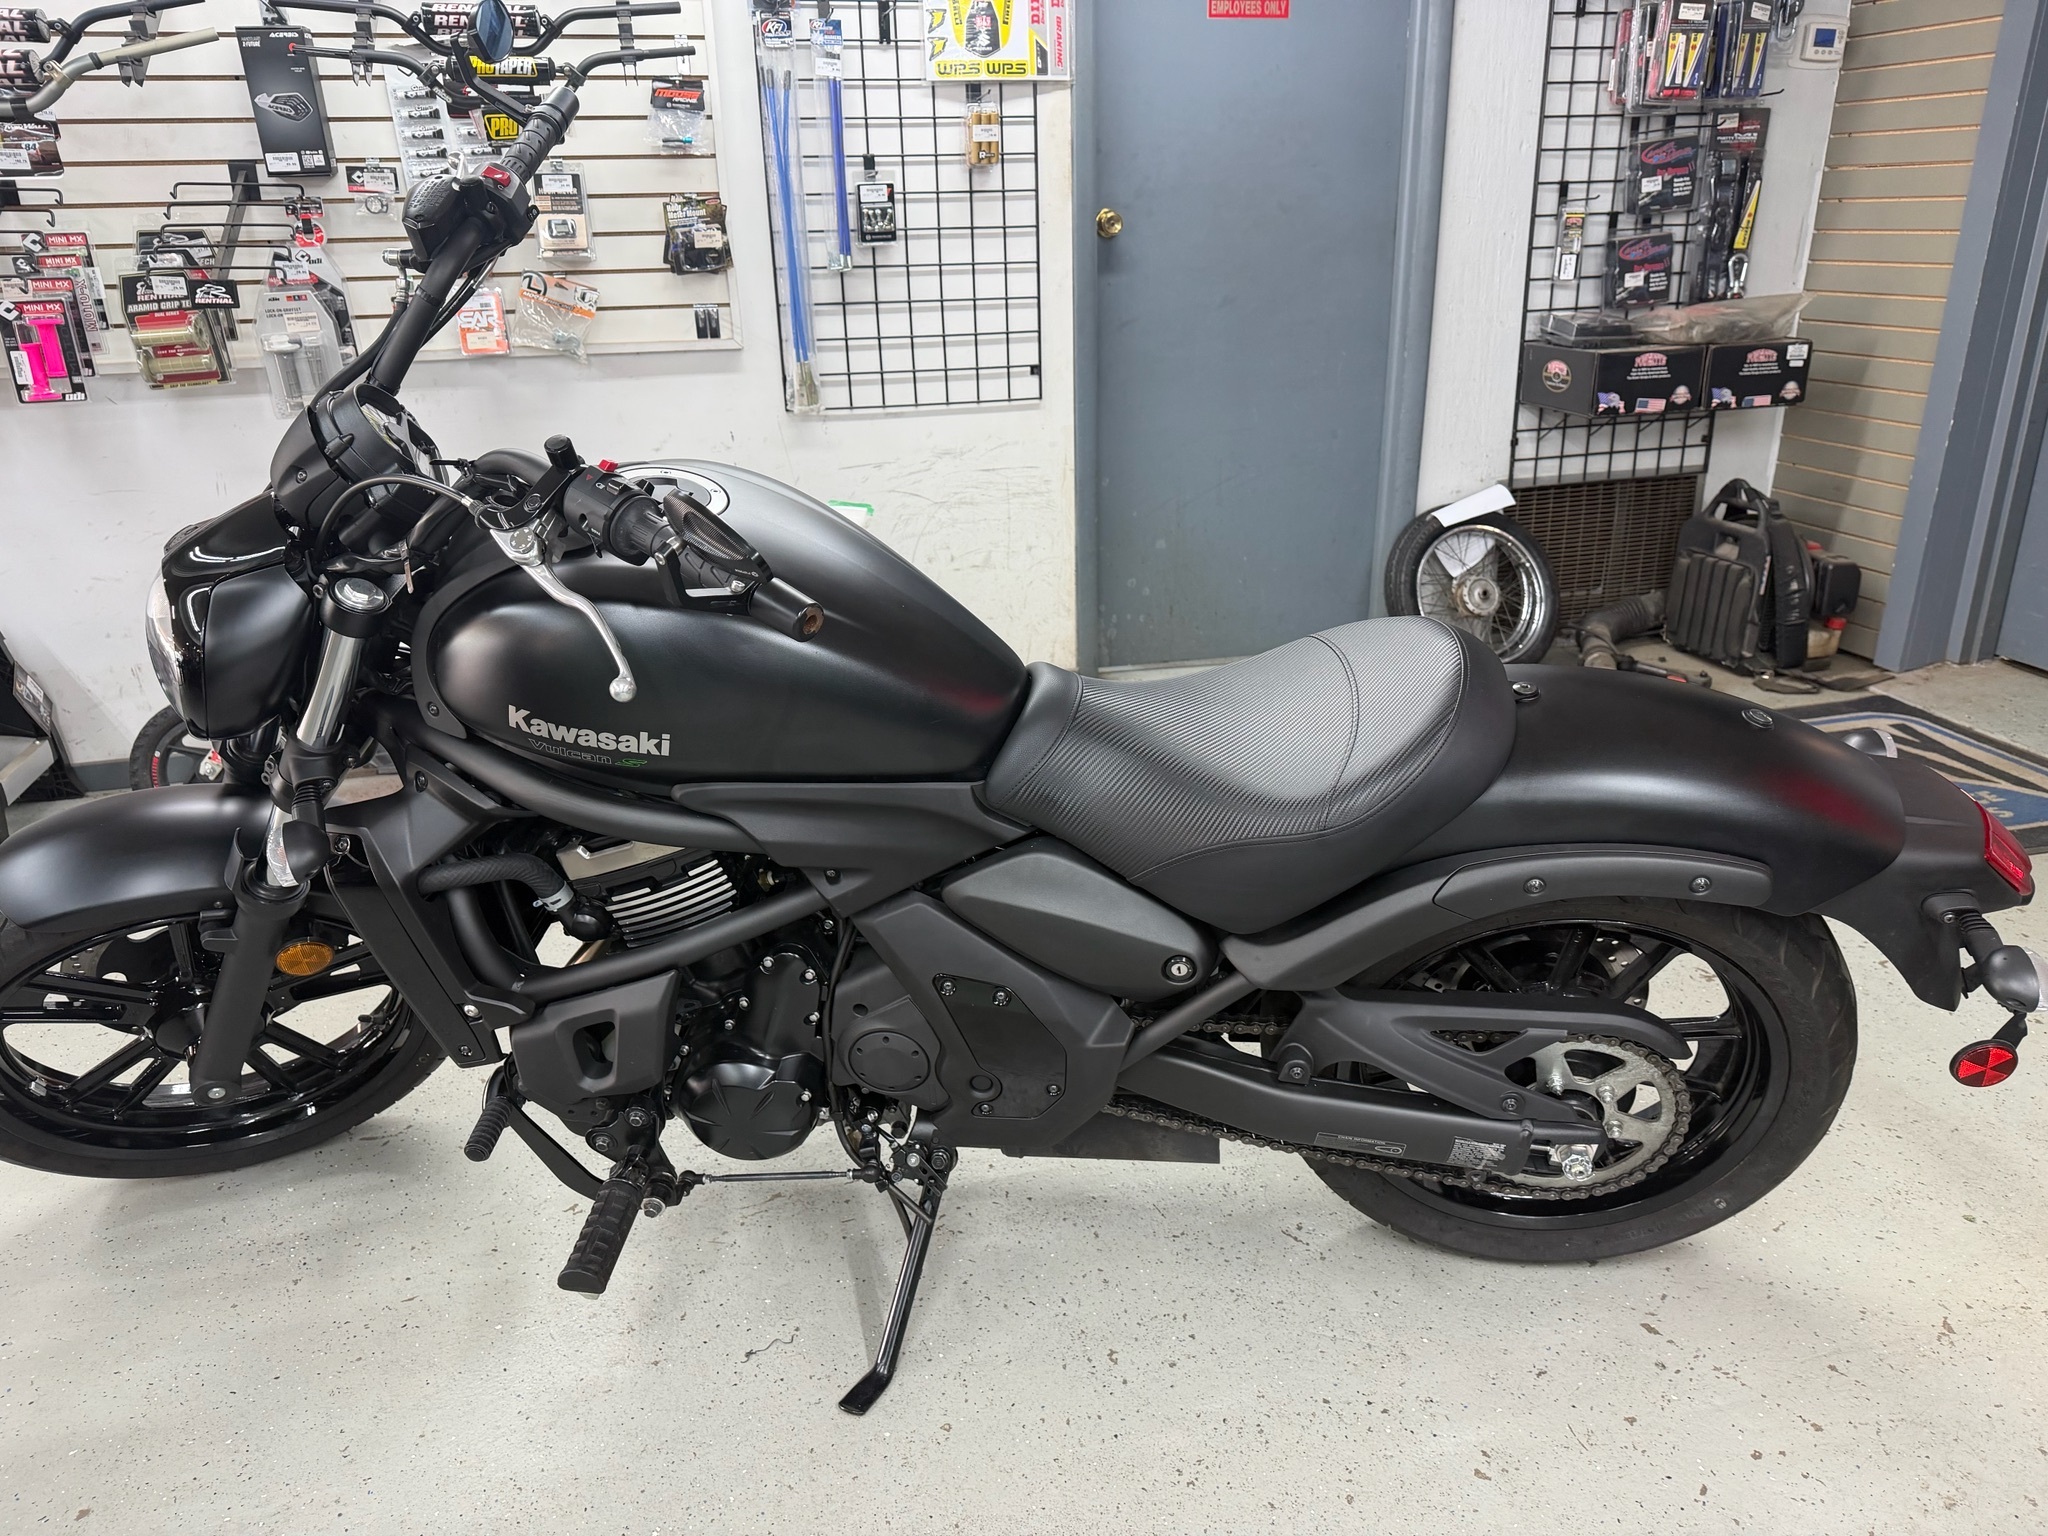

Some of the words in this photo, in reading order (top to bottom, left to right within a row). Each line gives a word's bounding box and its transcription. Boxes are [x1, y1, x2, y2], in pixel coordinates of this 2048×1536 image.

[1211, 0, 1261, 15] EMPLOYEES
[1264, 0, 1286, 15] ONLY
[937, 63, 980, 75] WPS
[987, 63, 1027, 75] WPS
[655, 88, 701, 99] MOOSE
[25, 143, 37, 151] 84
[48, 236, 67, 244] MINI
[69, 235, 84, 243] MX
[55, 280, 70, 288] MX
[23, 304, 43, 312] MINI
[127, 303, 158, 313] ARAMID
[160, 301, 180, 309] GRIP
[508, 704, 671, 756] Kawasaki
